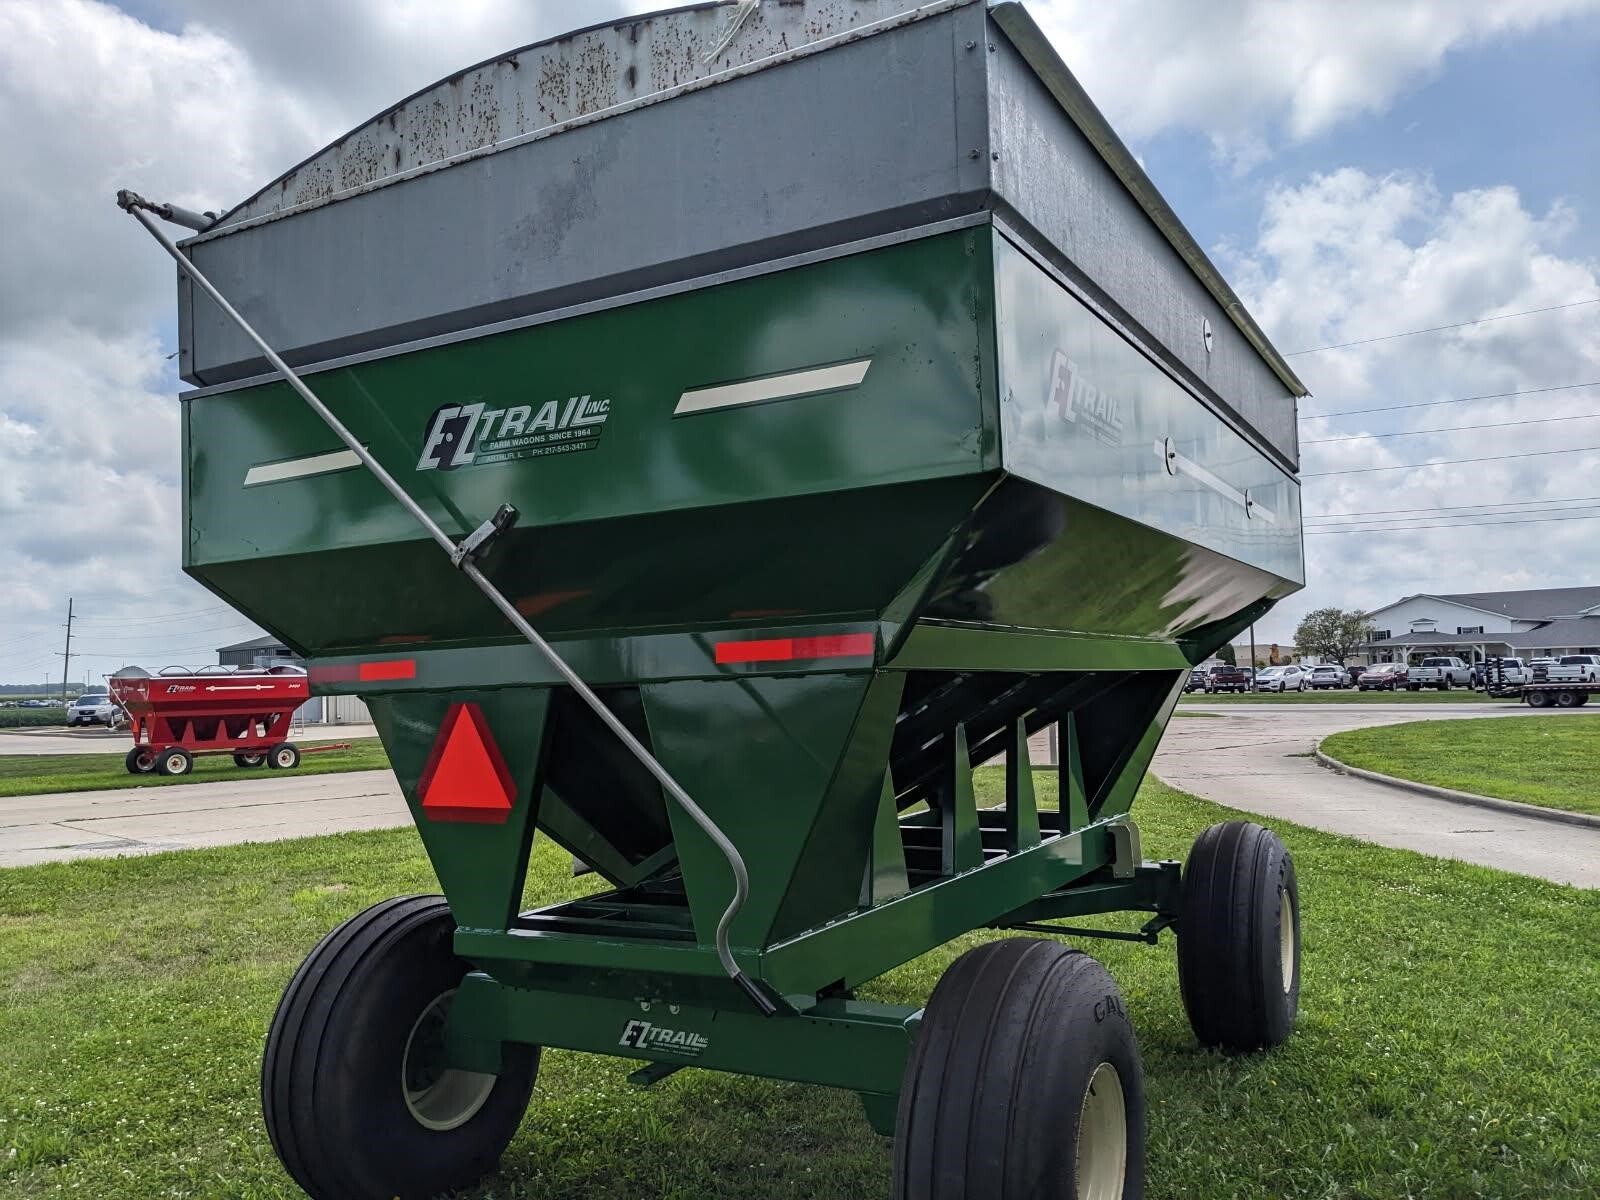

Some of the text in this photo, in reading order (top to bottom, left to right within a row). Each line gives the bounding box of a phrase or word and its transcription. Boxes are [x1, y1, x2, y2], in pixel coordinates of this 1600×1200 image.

[479, 394, 609, 441] TRAIL
[1073, 376, 1123, 430] TRAIL
[490, 428, 591, 449] FARM WAGONS SINCE 1964
[648, 1027, 708, 1048] TRAIL
